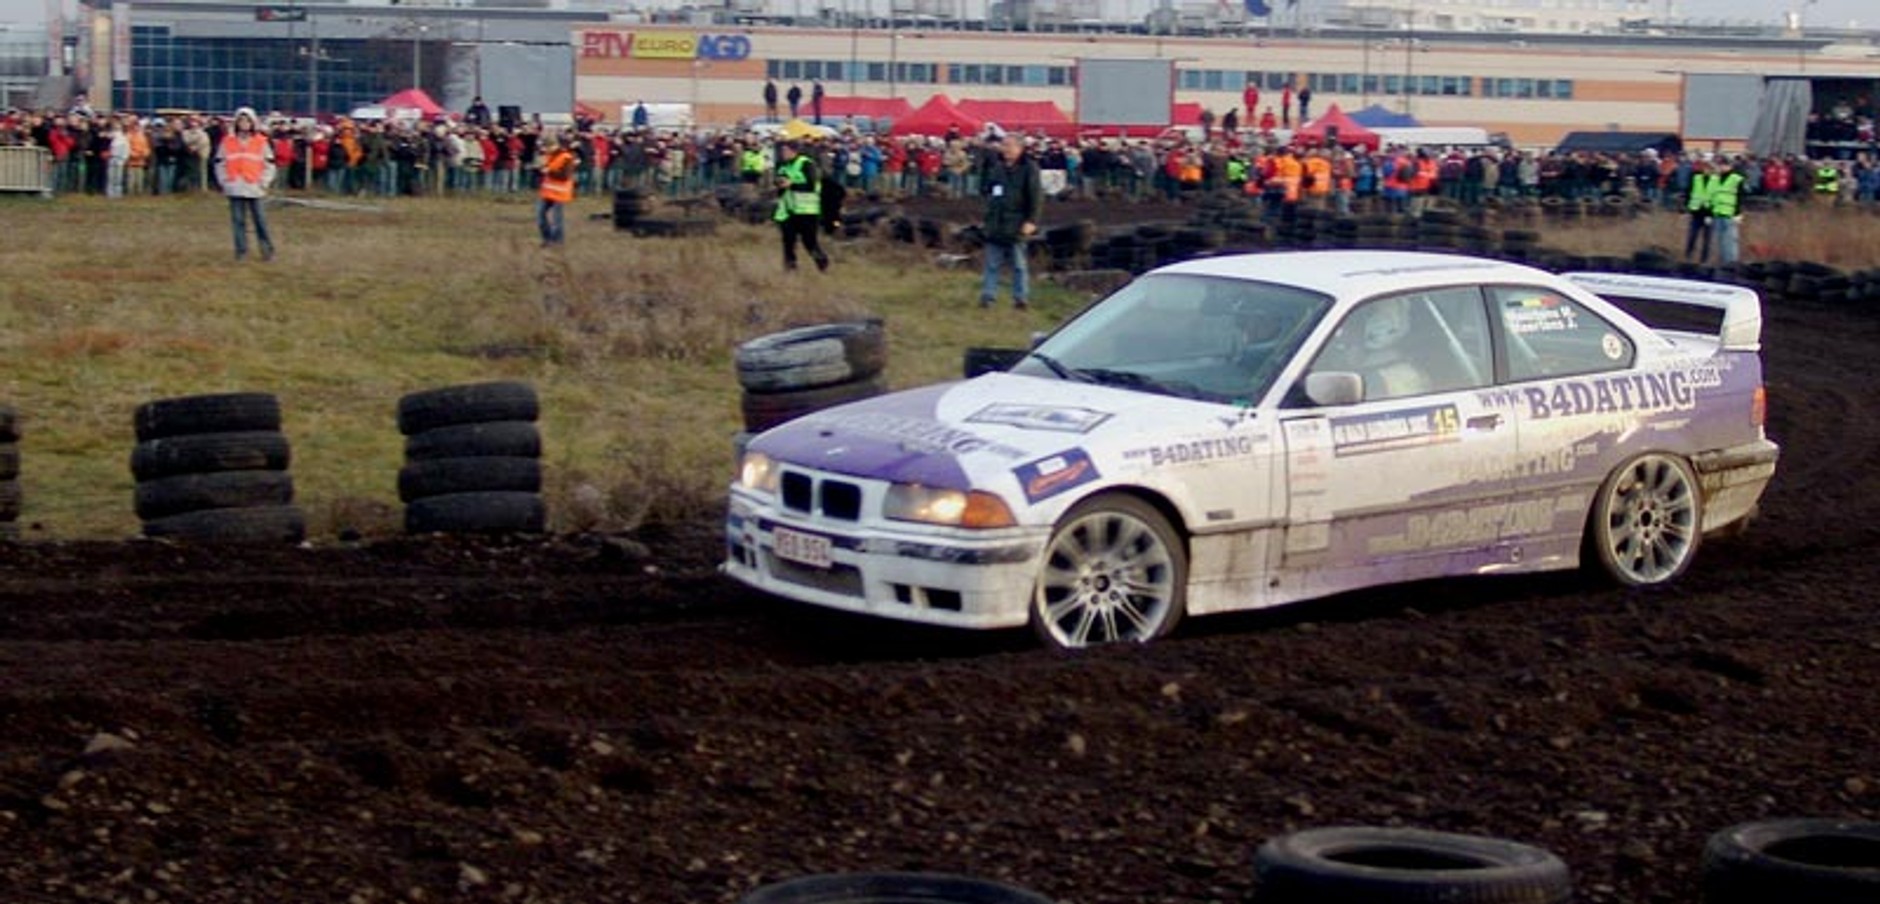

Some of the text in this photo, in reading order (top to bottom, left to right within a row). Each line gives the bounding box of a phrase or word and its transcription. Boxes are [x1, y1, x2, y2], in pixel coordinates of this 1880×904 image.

[582, 32, 752, 60] RTV EURO AGD
[1433, 405, 1458, 436] 15
